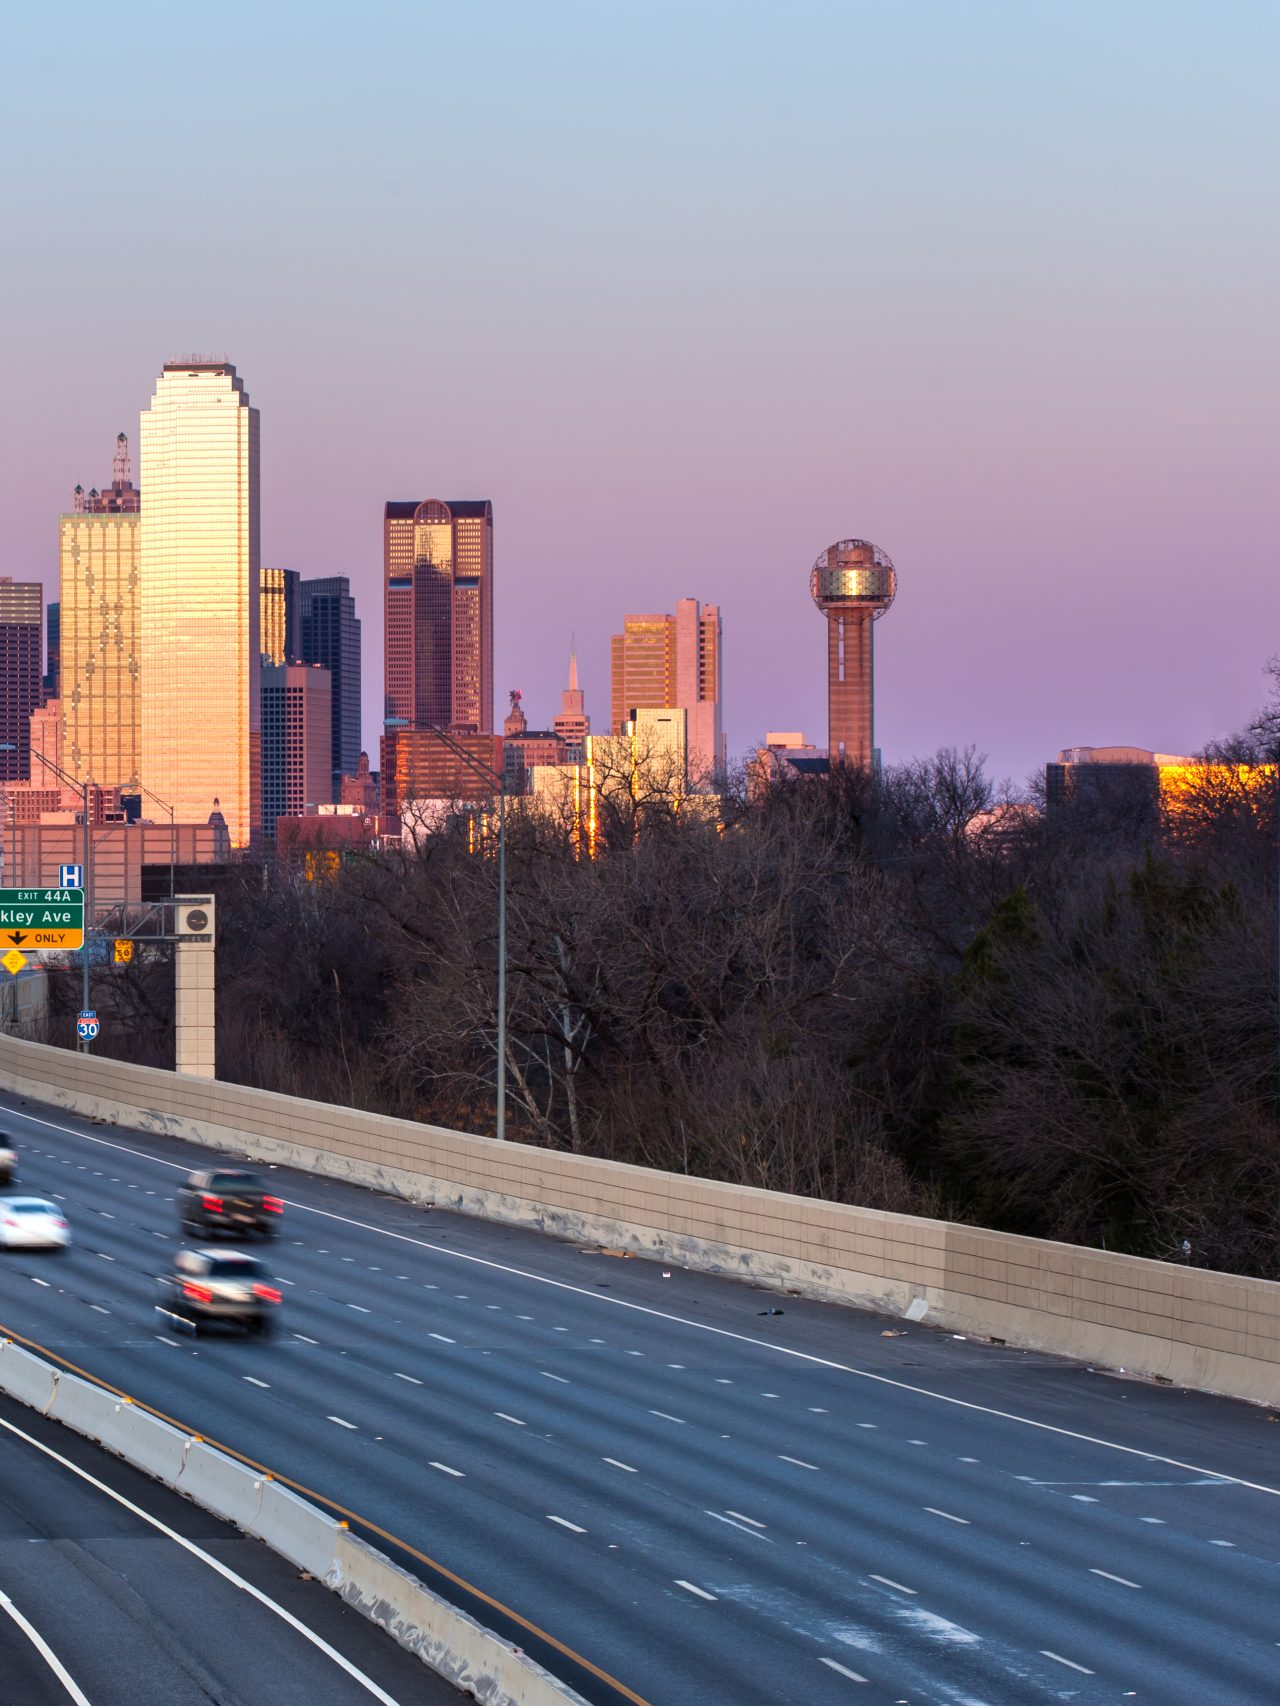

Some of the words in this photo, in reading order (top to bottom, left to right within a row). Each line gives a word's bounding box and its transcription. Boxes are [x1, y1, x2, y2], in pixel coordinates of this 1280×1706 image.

[62, 866, 79, 887] H
[17, 892, 38, 900] EXIT
[44, 890, 71, 901] 44A
[42, 910, 71, 922] Ave
[34, 933, 66, 943] ONLY
[79, 1024, 97, 1036] 30
